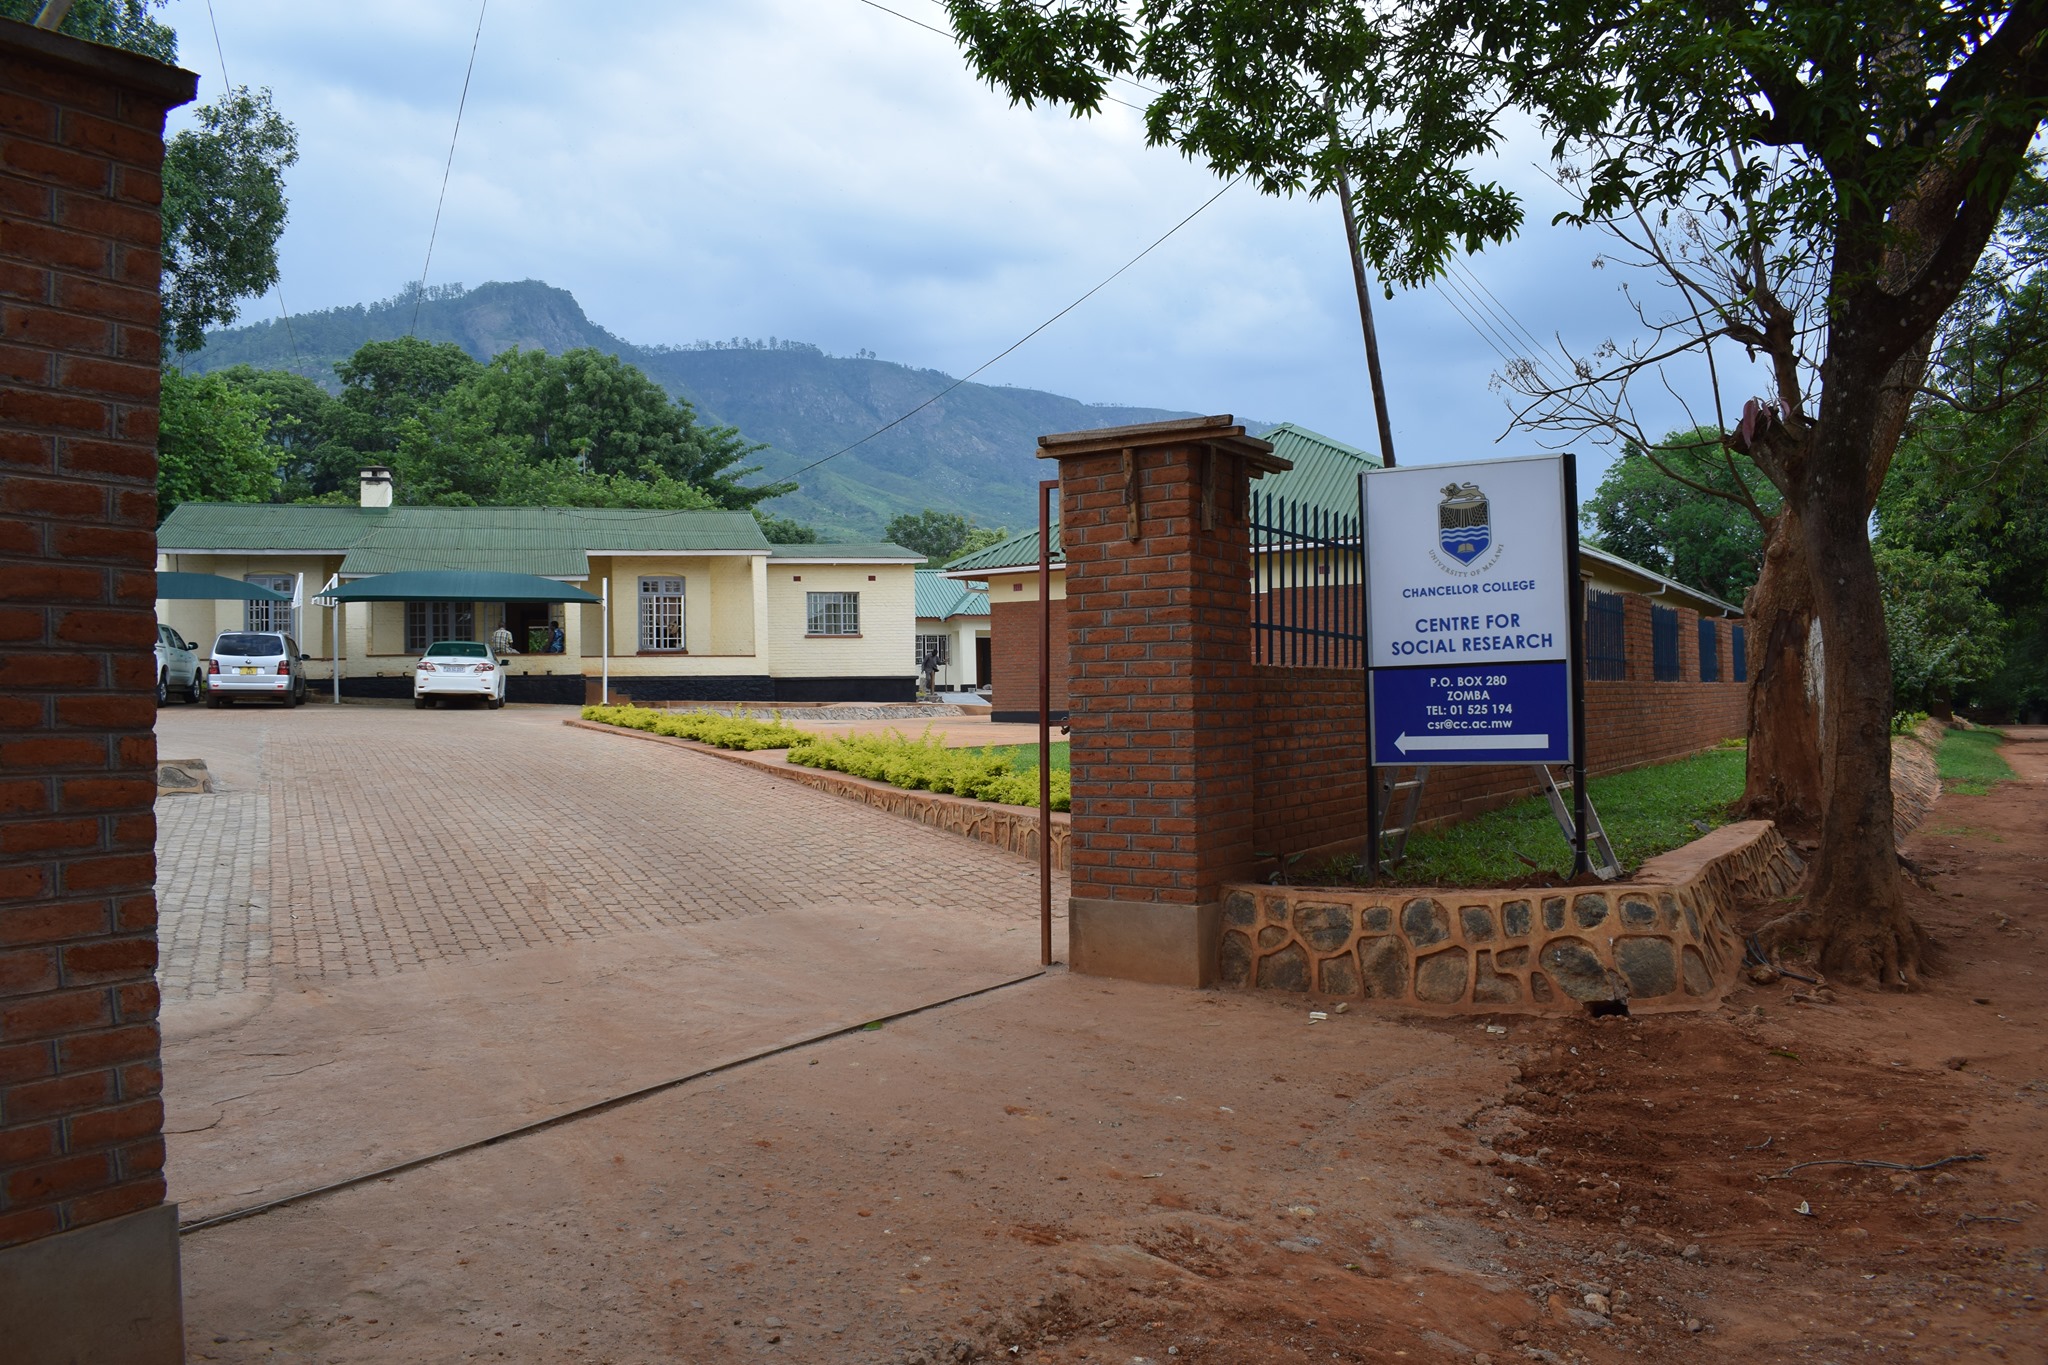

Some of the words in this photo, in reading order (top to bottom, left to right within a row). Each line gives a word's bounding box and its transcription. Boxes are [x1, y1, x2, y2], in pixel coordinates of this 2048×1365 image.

[1428, 549, 1468, 578] UNIVERSITY
[1470, 568, 1481, 577] OF
[1482, 543, 1504, 572] MALAWI
[1402, 584, 1479, 599] CHANCELLOR
[1482, 579, 1535, 593] COLLEGE
[1415, 615, 1479, 633] CENTRE
[1486, 613, 1520, 629] FOR
[1391, 638, 1456, 656] SOCIAL
[1463, 633, 1553, 652] RESEARCH
[1430, 677, 1454, 688] P.O.
[1457, 676, 1483, 687] BOX
[1485, 675, 1507, 686] 280
[1447, 690, 1490, 701] ZOMBA
[1426, 705, 1447, 716] TEL:
[1450, 704, 1464, 716] 01
[1467, 704, 1488, 715] 525
[1492, 703, 1512, 714] 194
[1427, 718, 1513, 731] csr@cc.ac.mw
